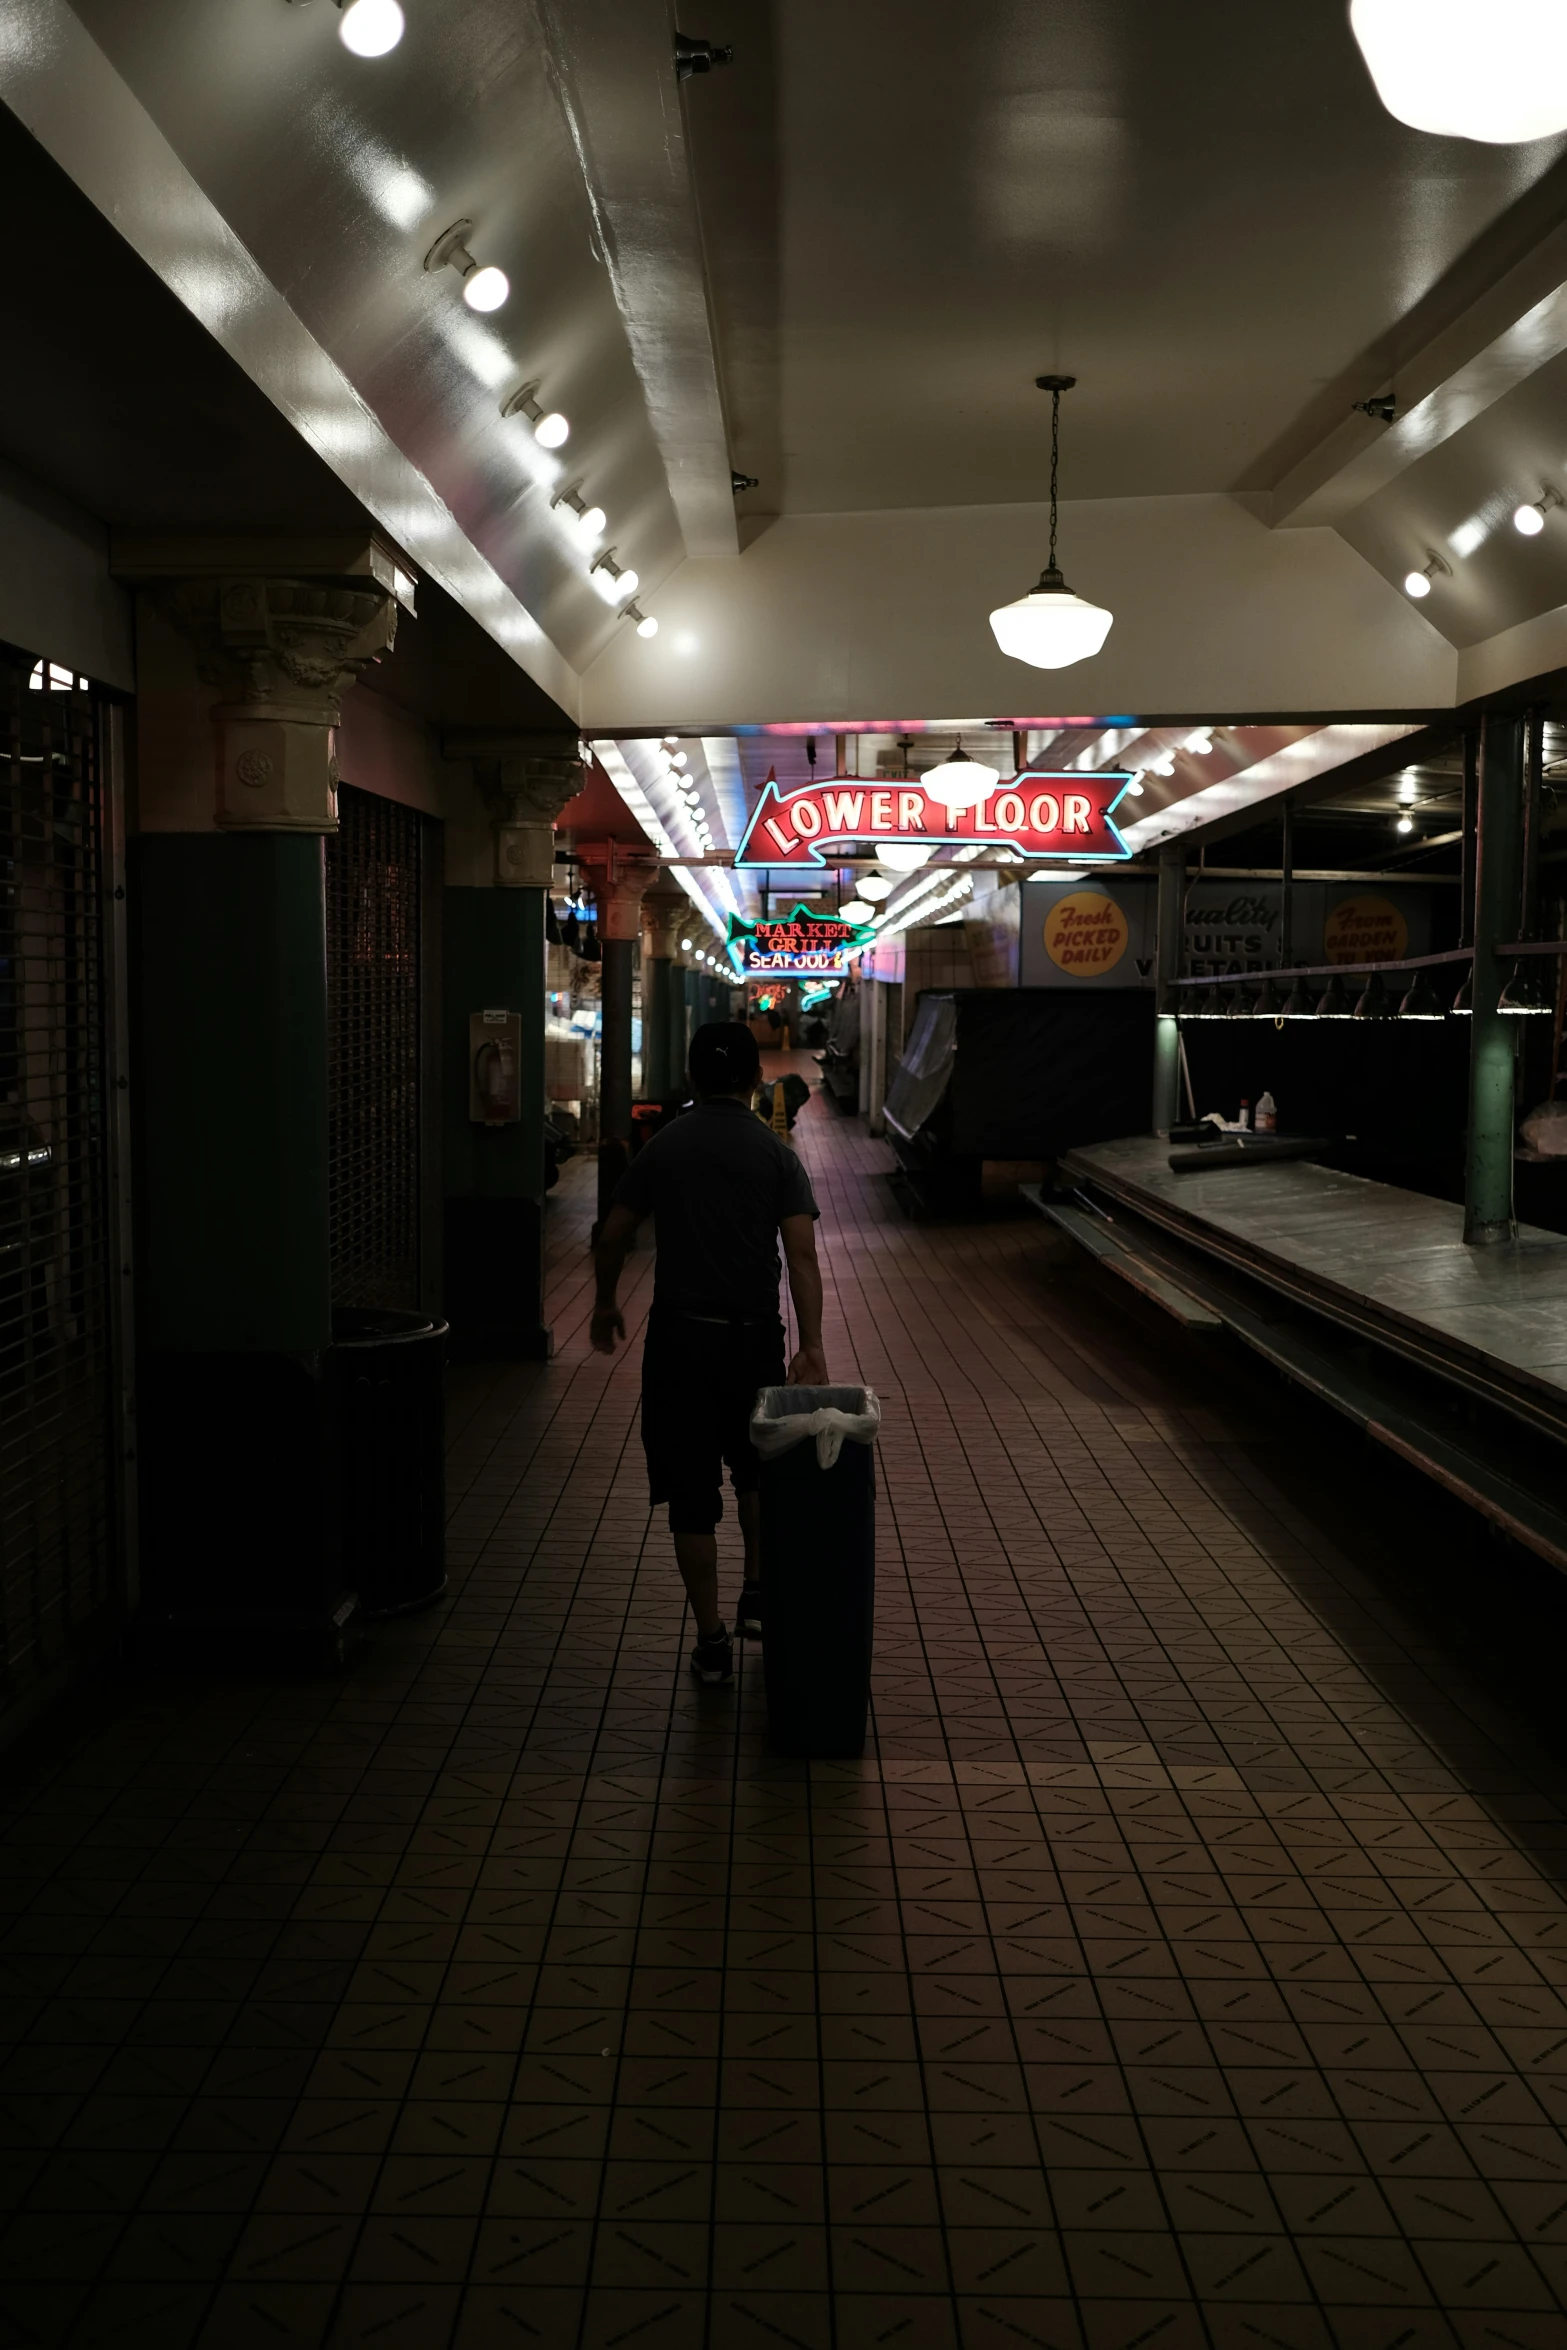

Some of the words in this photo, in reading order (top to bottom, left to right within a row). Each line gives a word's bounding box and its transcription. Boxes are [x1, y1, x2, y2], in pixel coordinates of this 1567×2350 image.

[762, 791, 927, 856] LOWER
[945, 792, 1092, 834] FLOOR
[1060, 902, 1113, 929] Fresh
[1186, 896, 1279, 933] uality
[1337, 907, 1393, 931] From
[755, 923, 852, 938] MARKET
[1053, 929, 1120, 947] PICKED
[768, 938, 837, 953] GRILL
[1327, 931, 1397, 949] GARDEN
[749, 951, 829, 969] SEAFOOD
[1061, 947, 1113, 964] DAILY
[1336, 952, 1356, 965] TO
[1365, 948, 1397, 962] YOU
